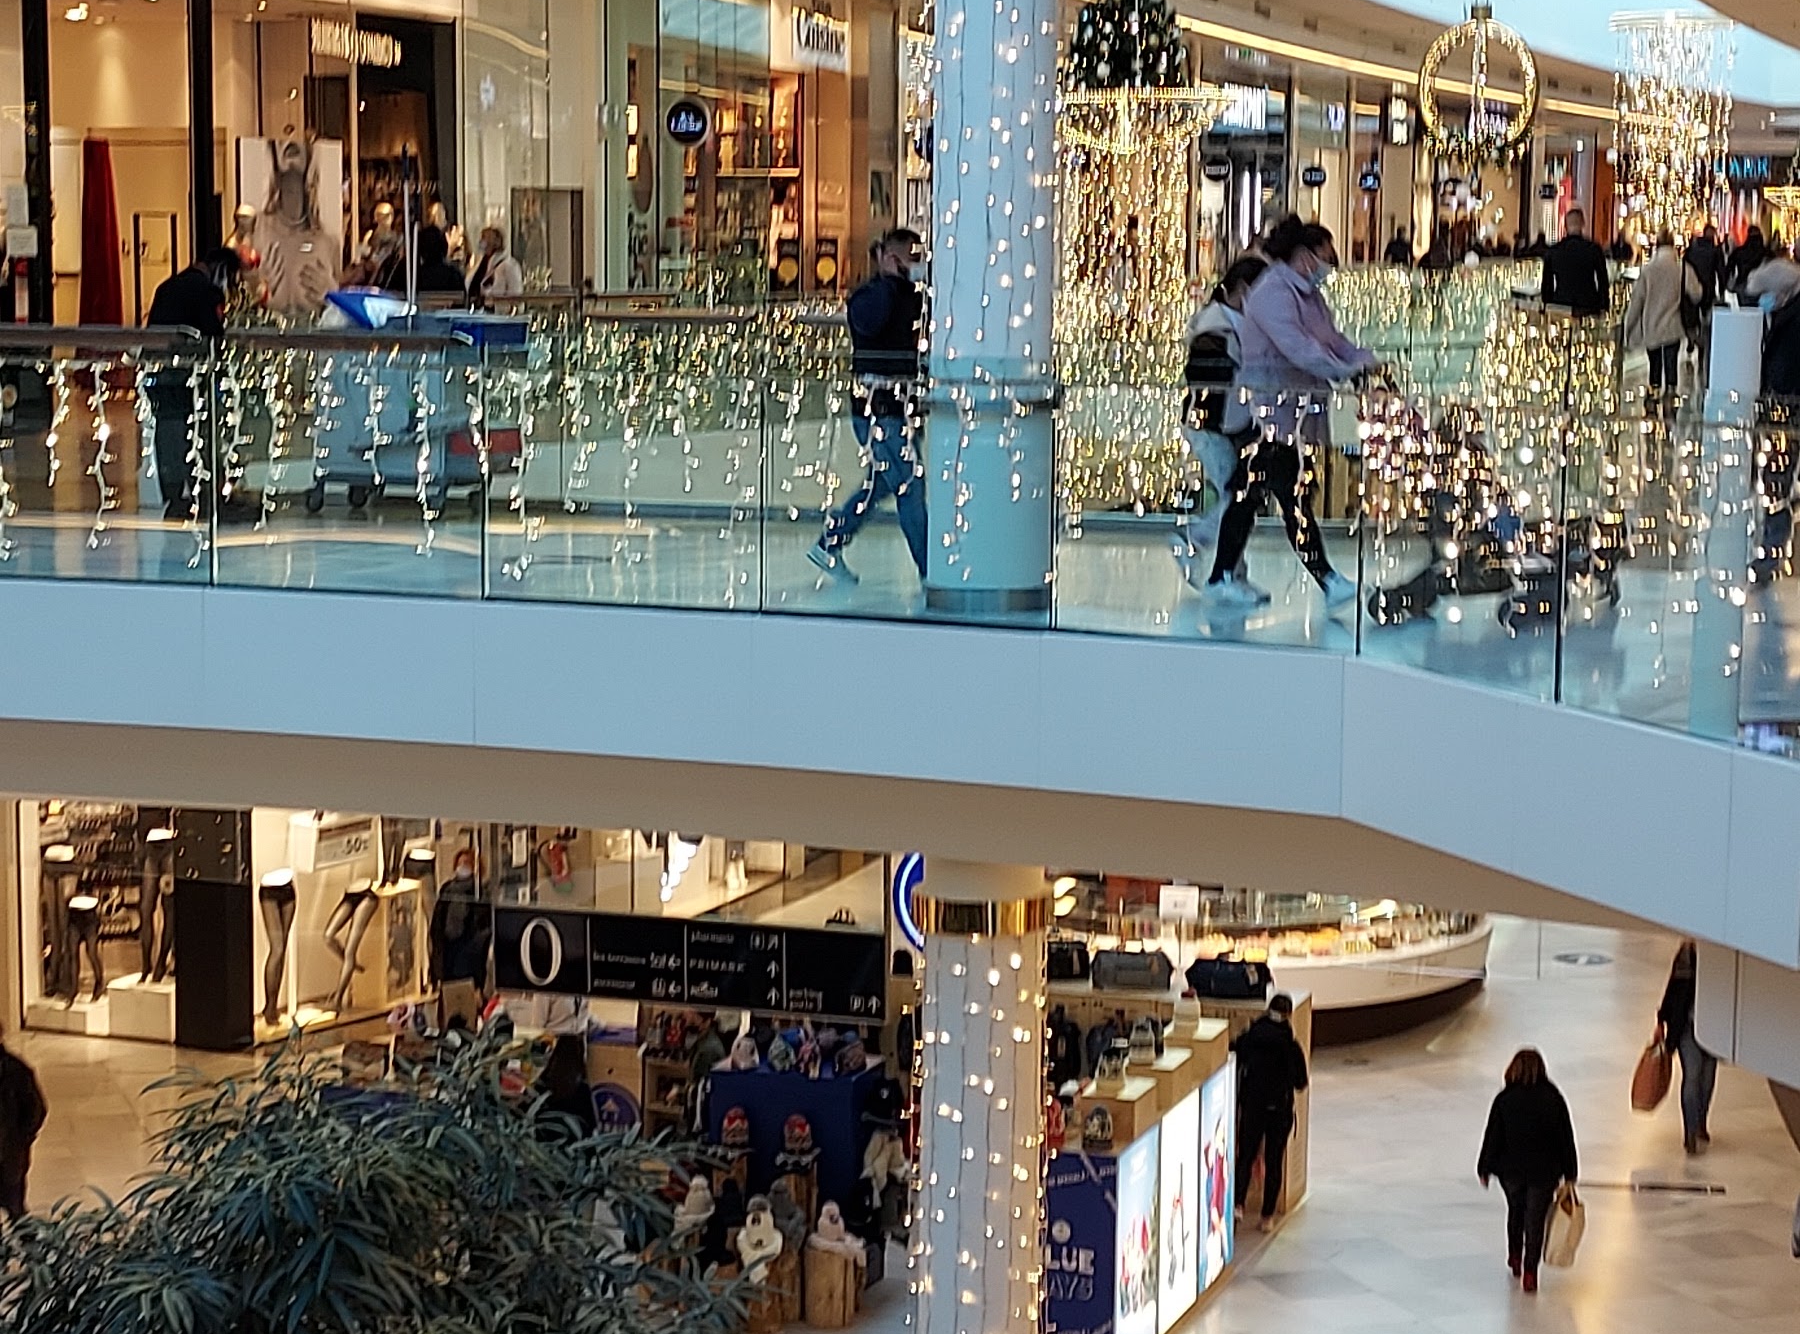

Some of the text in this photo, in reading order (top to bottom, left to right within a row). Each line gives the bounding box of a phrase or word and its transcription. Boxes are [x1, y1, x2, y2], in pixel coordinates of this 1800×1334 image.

[520, 916, 562, 986] 0
[689, 957, 746, 974] PRIMARK
[1045, 1244, 1095, 1275] LUE
[1047, 1273, 1093, 1301] AYS
